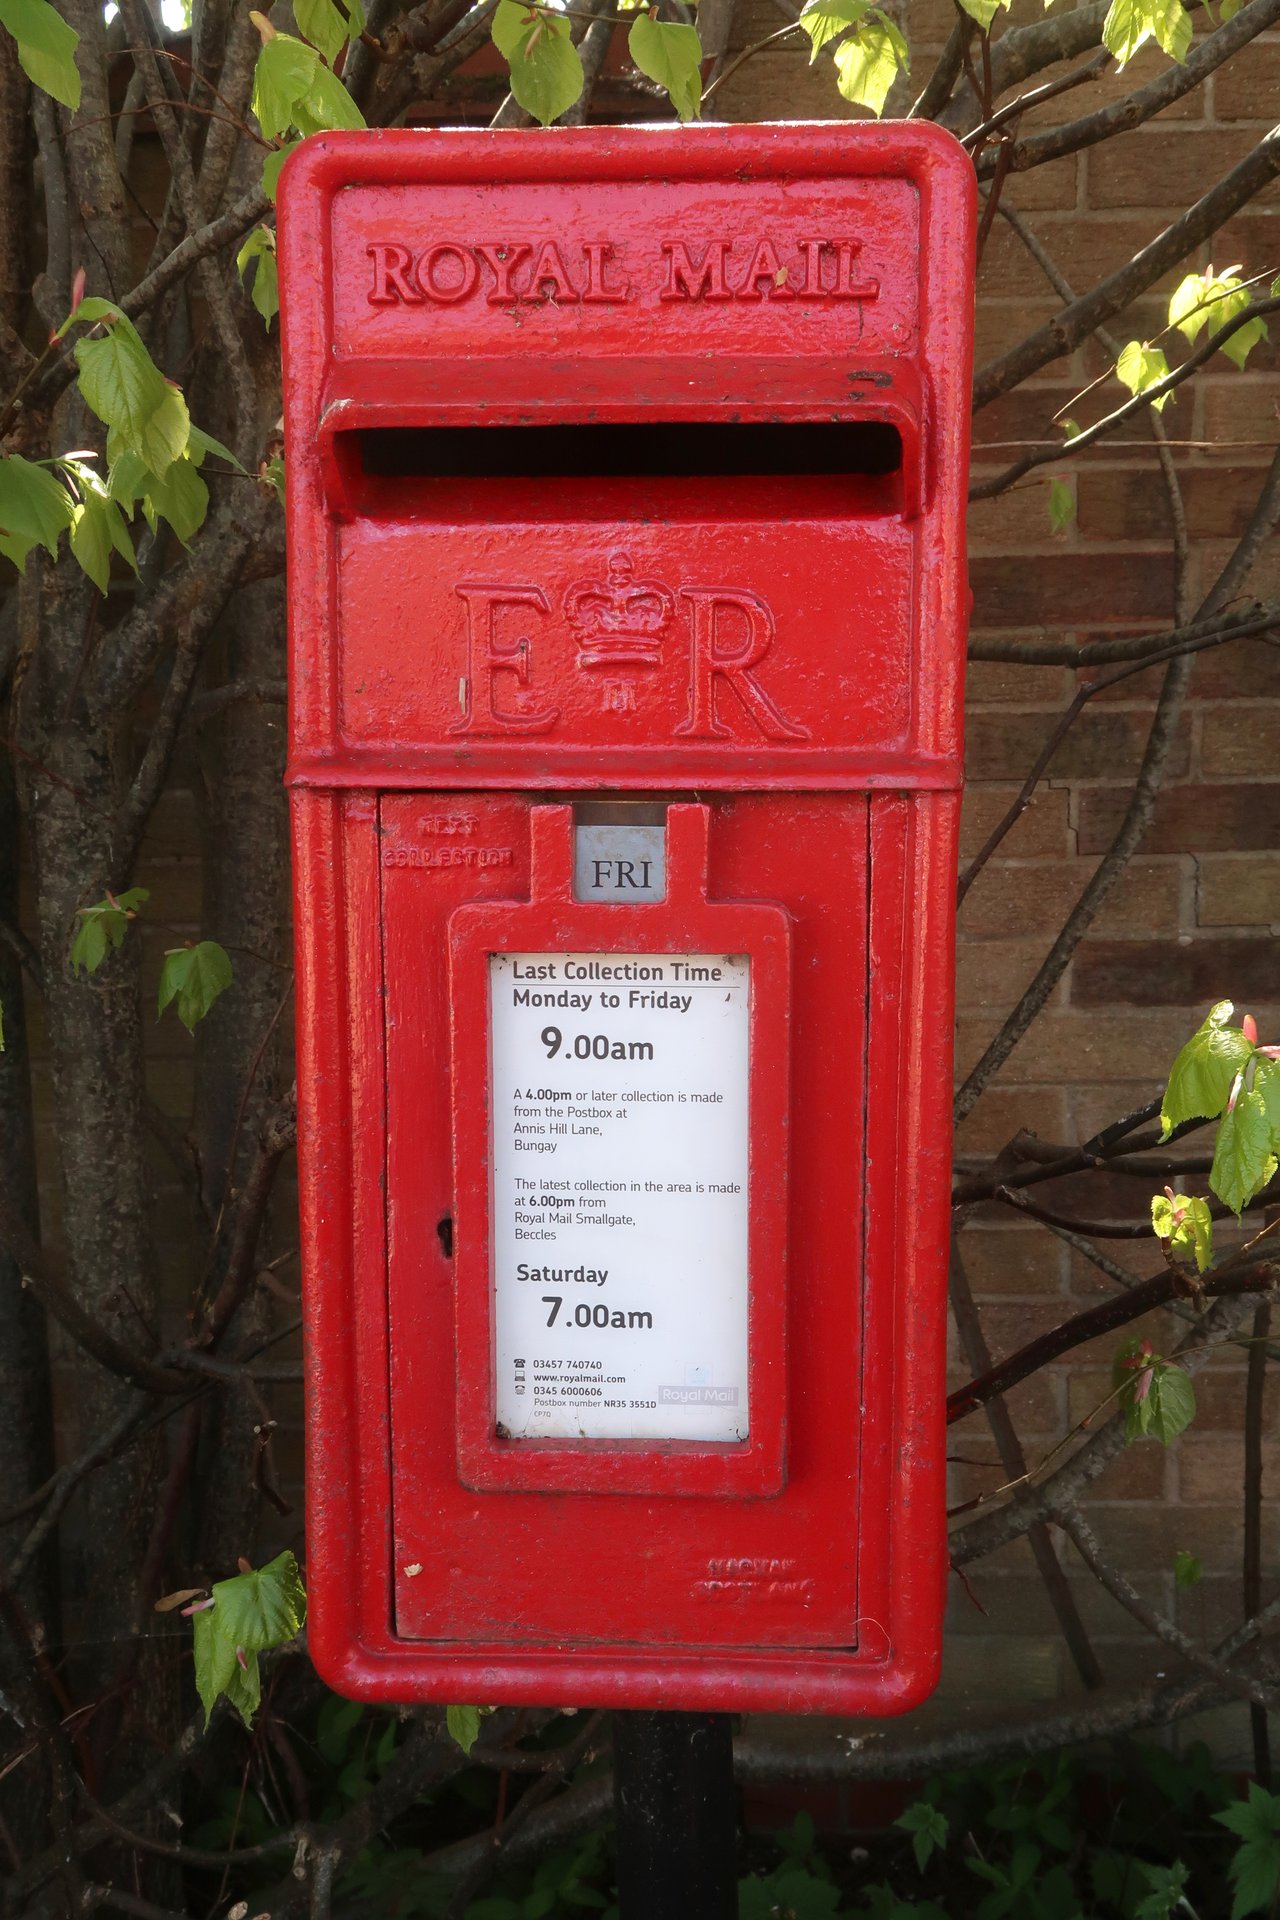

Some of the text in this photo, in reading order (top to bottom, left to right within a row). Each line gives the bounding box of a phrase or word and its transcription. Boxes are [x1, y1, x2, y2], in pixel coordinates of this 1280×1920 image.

[366, 238, 880, 305] ROYAL MAIL
[448, 583, 811, 740] E R
[592, 861, 652, 888] FRI
[512, 961, 723, 982] Last Collection Time
[514, 989, 692, 1014] Monday to Friday
[541, 1026, 653, 1061] 9.00am
[514, 1089, 723, 1104] A 4.00pm or later collection is made
[514, 1105, 627, 1119] from the Postbox at
[514, 1123, 602, 1137] Annis Hill Lane,
[515, 1139, 557, 1154] Bungay
[514, 1178, 740, 1194] The latest collection in the area is made
[515, 1196, 606, 1210] at 6.00pm from
[515, 1212, 635, 1228] Royal Mail Smallgate,
[515, 1228, 556, 1241] Beccles
[517, 1264, 608, 1287] Saturday
[542, 1296, 652, 1330] 7.00am
[533, 1360, 602, 1370] 03457 740740
[534, 1374, 625, 1384] www.royalmail.com
[534, 1386, 602, 1397] 0345 6000606
[662, 1389, 735, 1403] Royal Mail
[534, 1398, 566, 1407] Postbox
[569, 1400, 601, 1408] number
[604, 1400, 626, 1408] NR35
